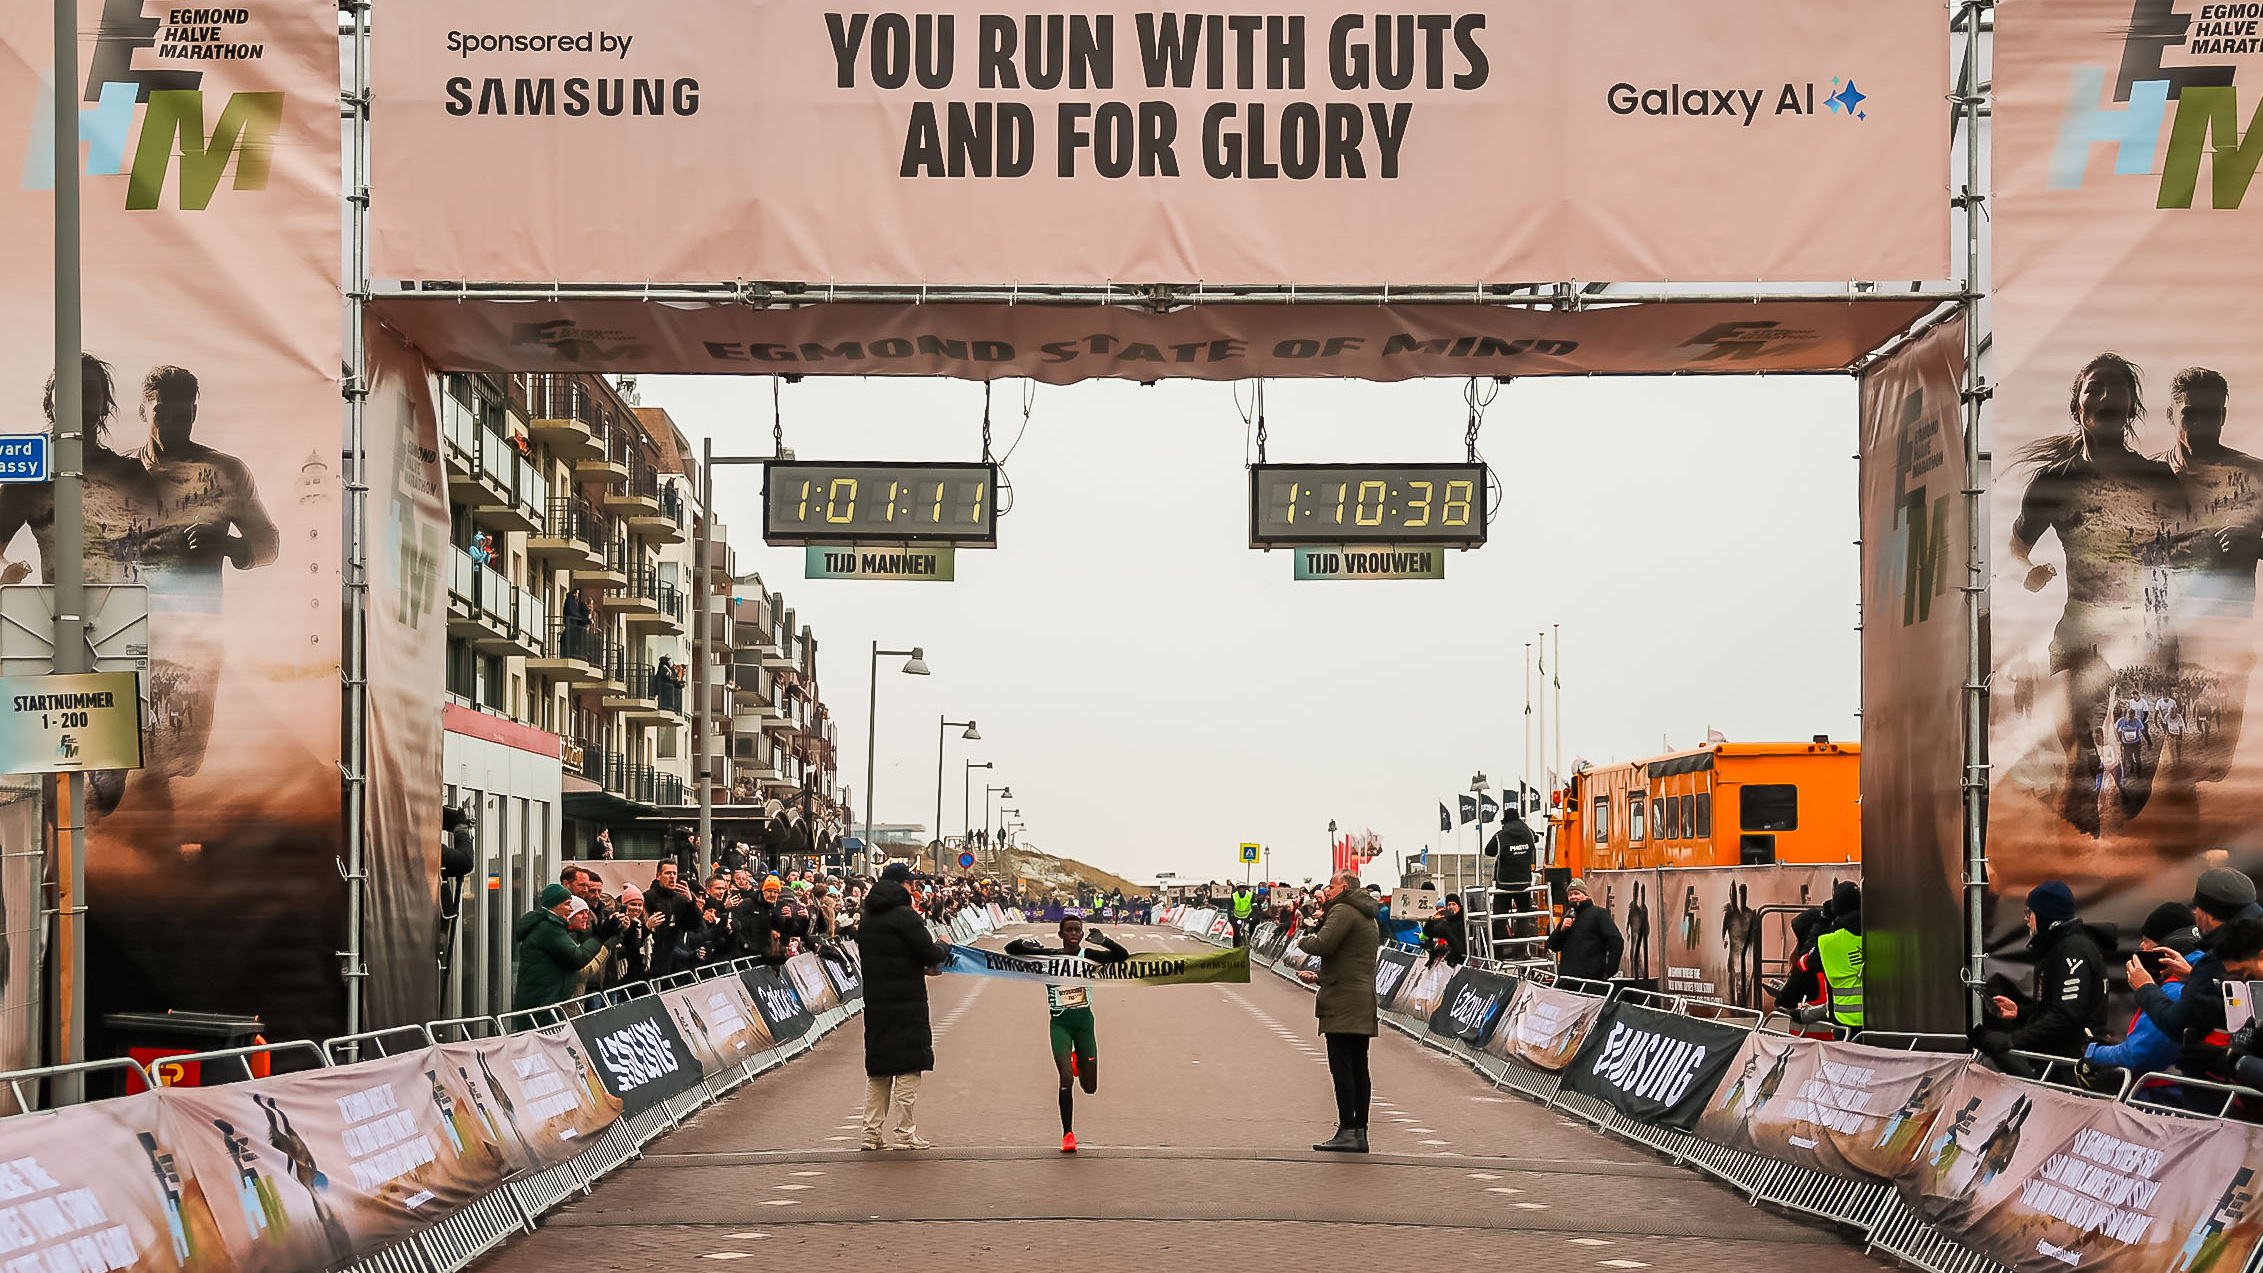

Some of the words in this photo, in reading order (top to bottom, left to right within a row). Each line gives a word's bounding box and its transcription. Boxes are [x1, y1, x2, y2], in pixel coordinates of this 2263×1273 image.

[169, 9, 249, 24] EGMOND
[2201, 4, 2263, 19] EGMO
[164, 27, 221, 42] HALVE
[2196, 21, 2258, 37] HALVE
[159, 44, 263, 59] MARATHON
[447, 31, 592, 58] Sponsored
[600, 31, 633, 59] by
[826, 14, 954, 89] YOU
[979, 14, 1113, 89] RUN
[1136, 14, 1305, 90] WITH
[1329, 14, 1489, 91] GUTS
[446, 77, 699, 116] SAMSUNG
[1608, 83, 1763, 126] Galaxy
[1775, 83, 1813, 115] AI
[900, 102, 1034, 178] AND
[1058, 102, 1179, 178] FOR
[1202, 102, 1412, 179] GLORY
[703, 335, 1015, 362] EGMOND
[1041, 334, 1249, 363] STATE
[1272, 337, 1365, 358] OF
[1382, 334, 1579, 357] MIND
[798, 479, 984, 524] 1:01:11
[1287, 481, 1474, 526] 1:10:38
[824, 553, 857, 574] TIJD
[862, 554, 937, 574] MANNEN
[1307, 553, 1340, 574] TIJD
[1344, 552, 1432, 574] VROUWEN
[14, 691, 114, 712] STARTNUMMER
[42, 713, 49, 729] 1
[61, 712, 88, 728] 200
